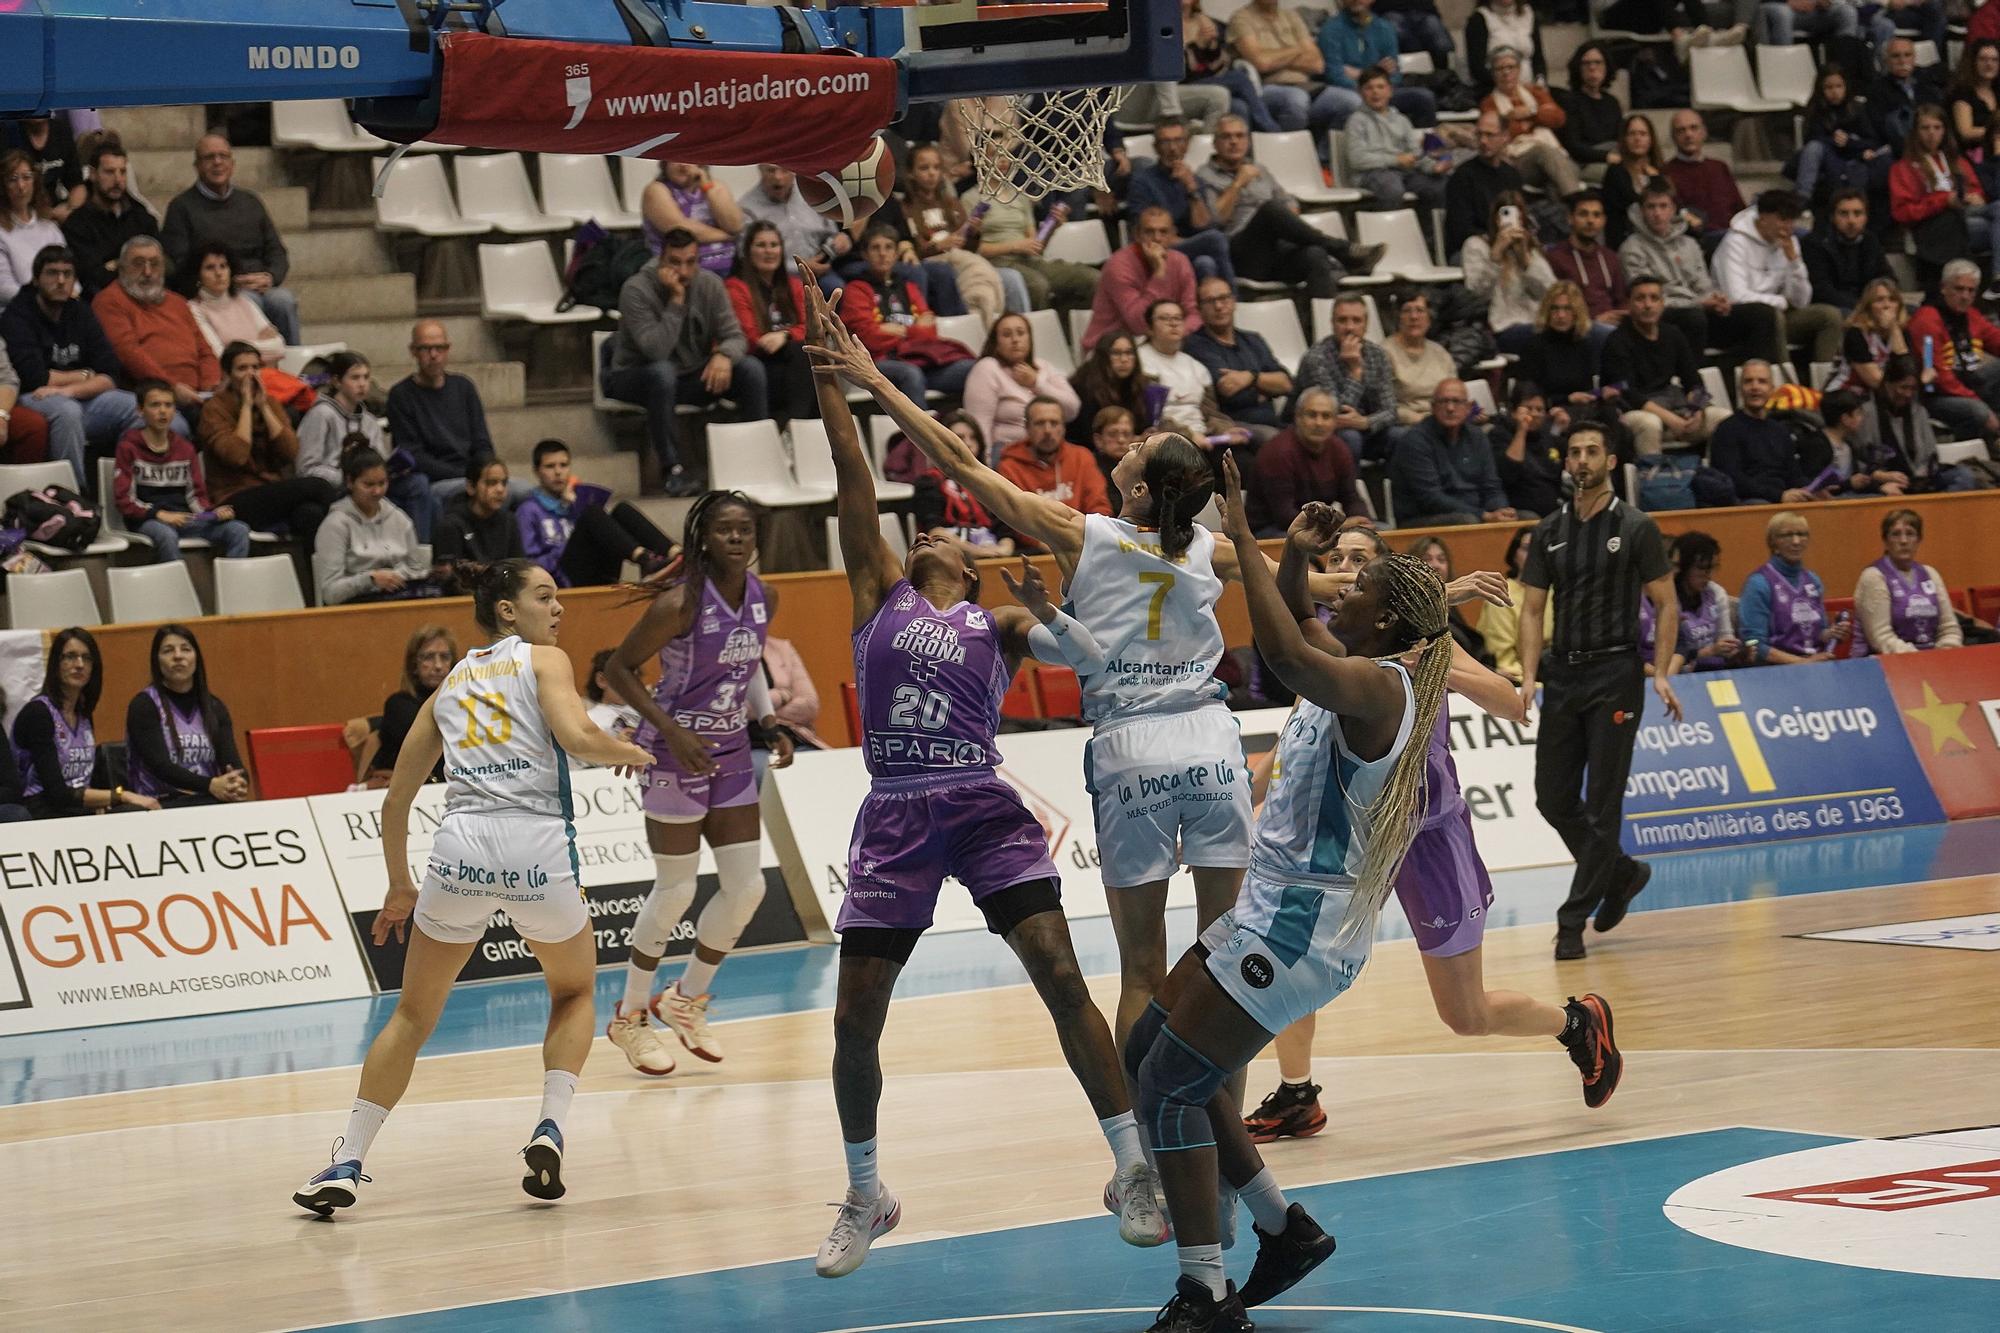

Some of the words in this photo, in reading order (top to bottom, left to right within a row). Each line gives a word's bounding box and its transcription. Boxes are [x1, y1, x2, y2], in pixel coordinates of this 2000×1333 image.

[248, 46, 361, 70] MONDO
[565, 63, 590, 77] 365
[605, 72, 870, 118] www.platjadaro.com
[1138, 571, 1176, 641] 7
[726, 631, 761, 651] SPAR
[891, 631, 967, 666] GIRONA
[908, 620, 958, 645] SPAR
[717, 645, 763, 665] GIRONA
[1105, 658, 1206, 676] Alcantarilla
[458, 691, 513, 749] 13
[675, 713, 742, 731] SPAR
[888, 683, 952, 732] 20
[1756, 706, 1879, 743] Ceigrup
[1118, 784, 1133, 806] la
[1138, 774, 1181, 799] boca
[1186, 766, 1209, 788] te
[1215, 759, 1235, 786] lía
[1126, 806, 1149, 820] MÁS
[1150, 798, 1172, 813] QUE
[1172, 792, 1234, 803] BOCADILLOS
[1632, 811, 1768, 847] Immobiliària
[1772, 804, 1812, 832] des
[1815, 800, 1846, 826] de
[1850, 795, 1905, 823] 1963
[0, 829, 307, 890] EMBALATGES
[458, 859, 496, 885] boca
[501, 868, 520, 889] te
[527, 864, 548, 889] lía
[440, 882, 460, 895] MÁS
[461, 888, 483, 897] QUE
[485, 890, 545, 901] BOCADILLOS
[21, 883, 333, 969] GIRONA
[57, 964, 332, 1005] WWW.EMBALATGESGIRONA.COM
[1245, 960, 1268, 982] 1954
